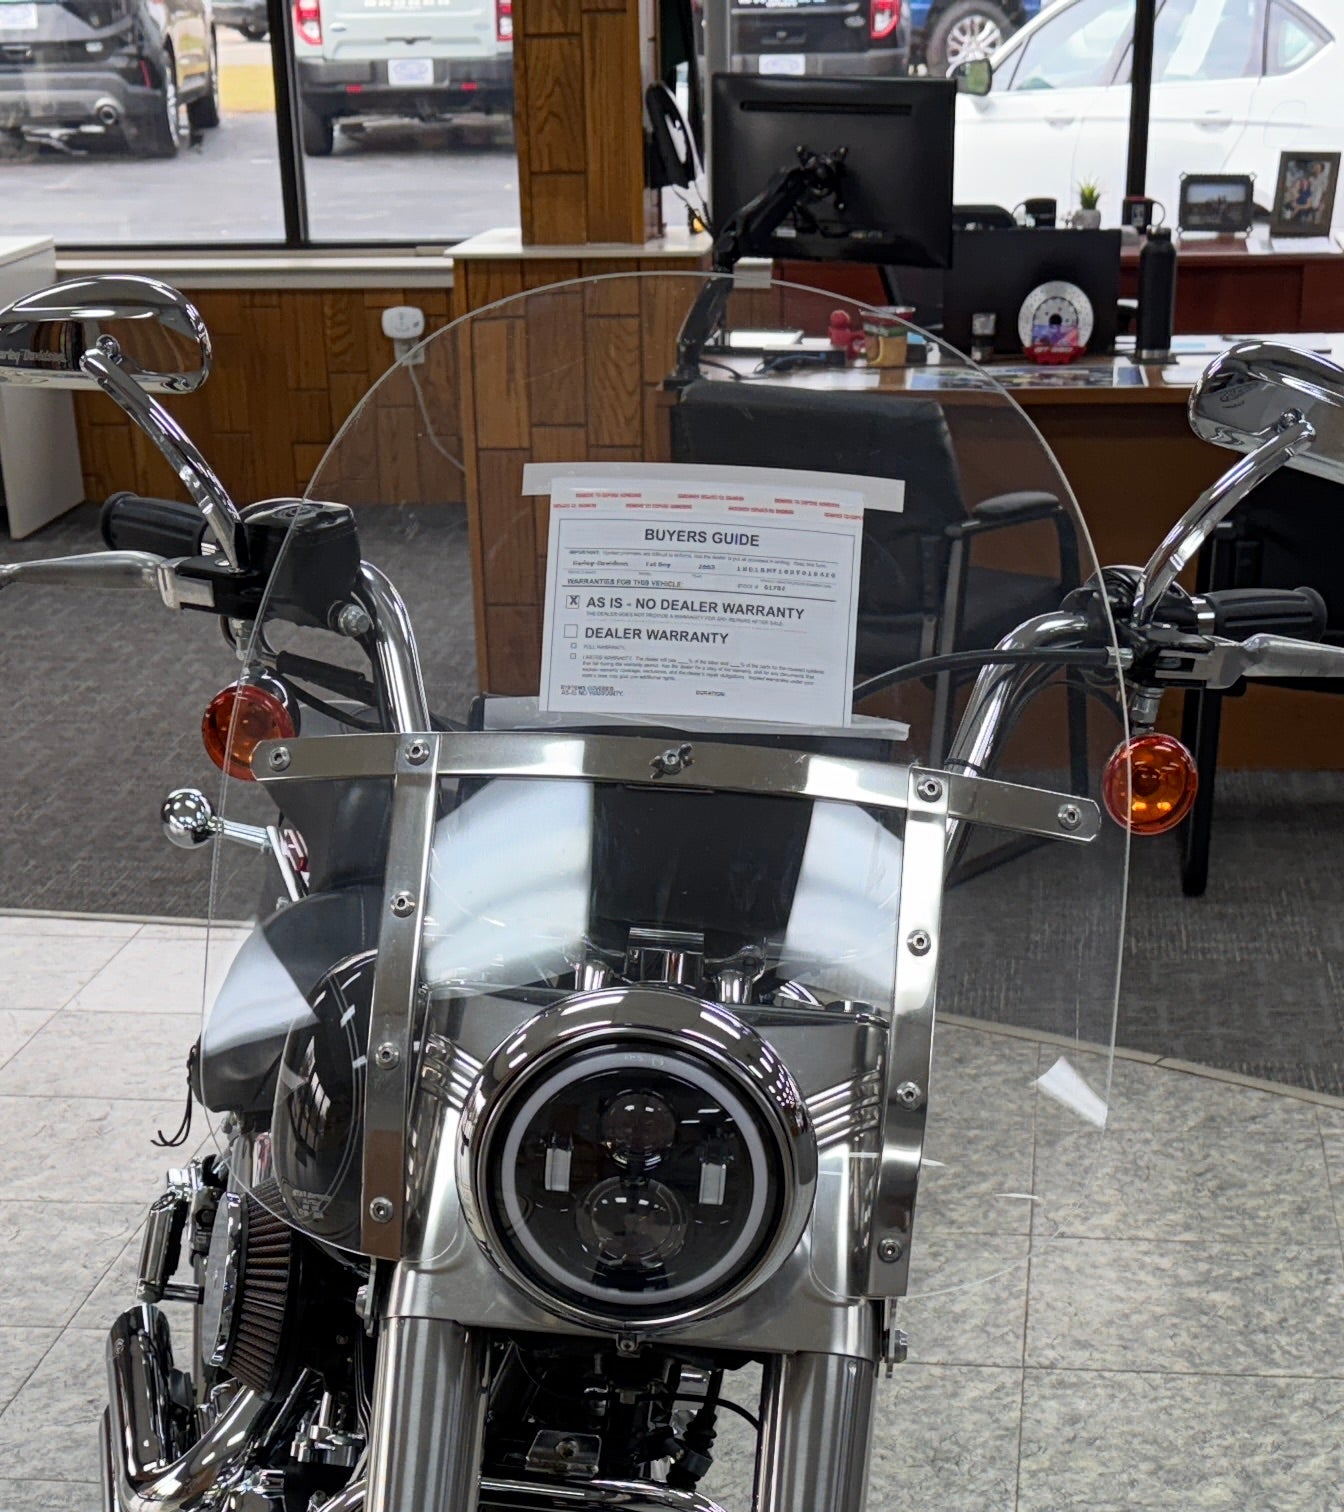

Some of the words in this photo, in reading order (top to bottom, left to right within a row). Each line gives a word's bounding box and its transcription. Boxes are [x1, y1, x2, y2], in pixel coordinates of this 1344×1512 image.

[644, 528, 707, 543] BUYERS
[712, 531, 760, 547] GUIDE
[586, 596, 606, 608] AS
[609, 597, 623, 609] IS
[635, 598, 656, 610] NO
[660, 599, 718, 613] DEALER
[722, 602, 805, 620] WARRANTY
[585, 627, 642, 640] DEALER
[646, 630, 729, 645] WARRANTY
